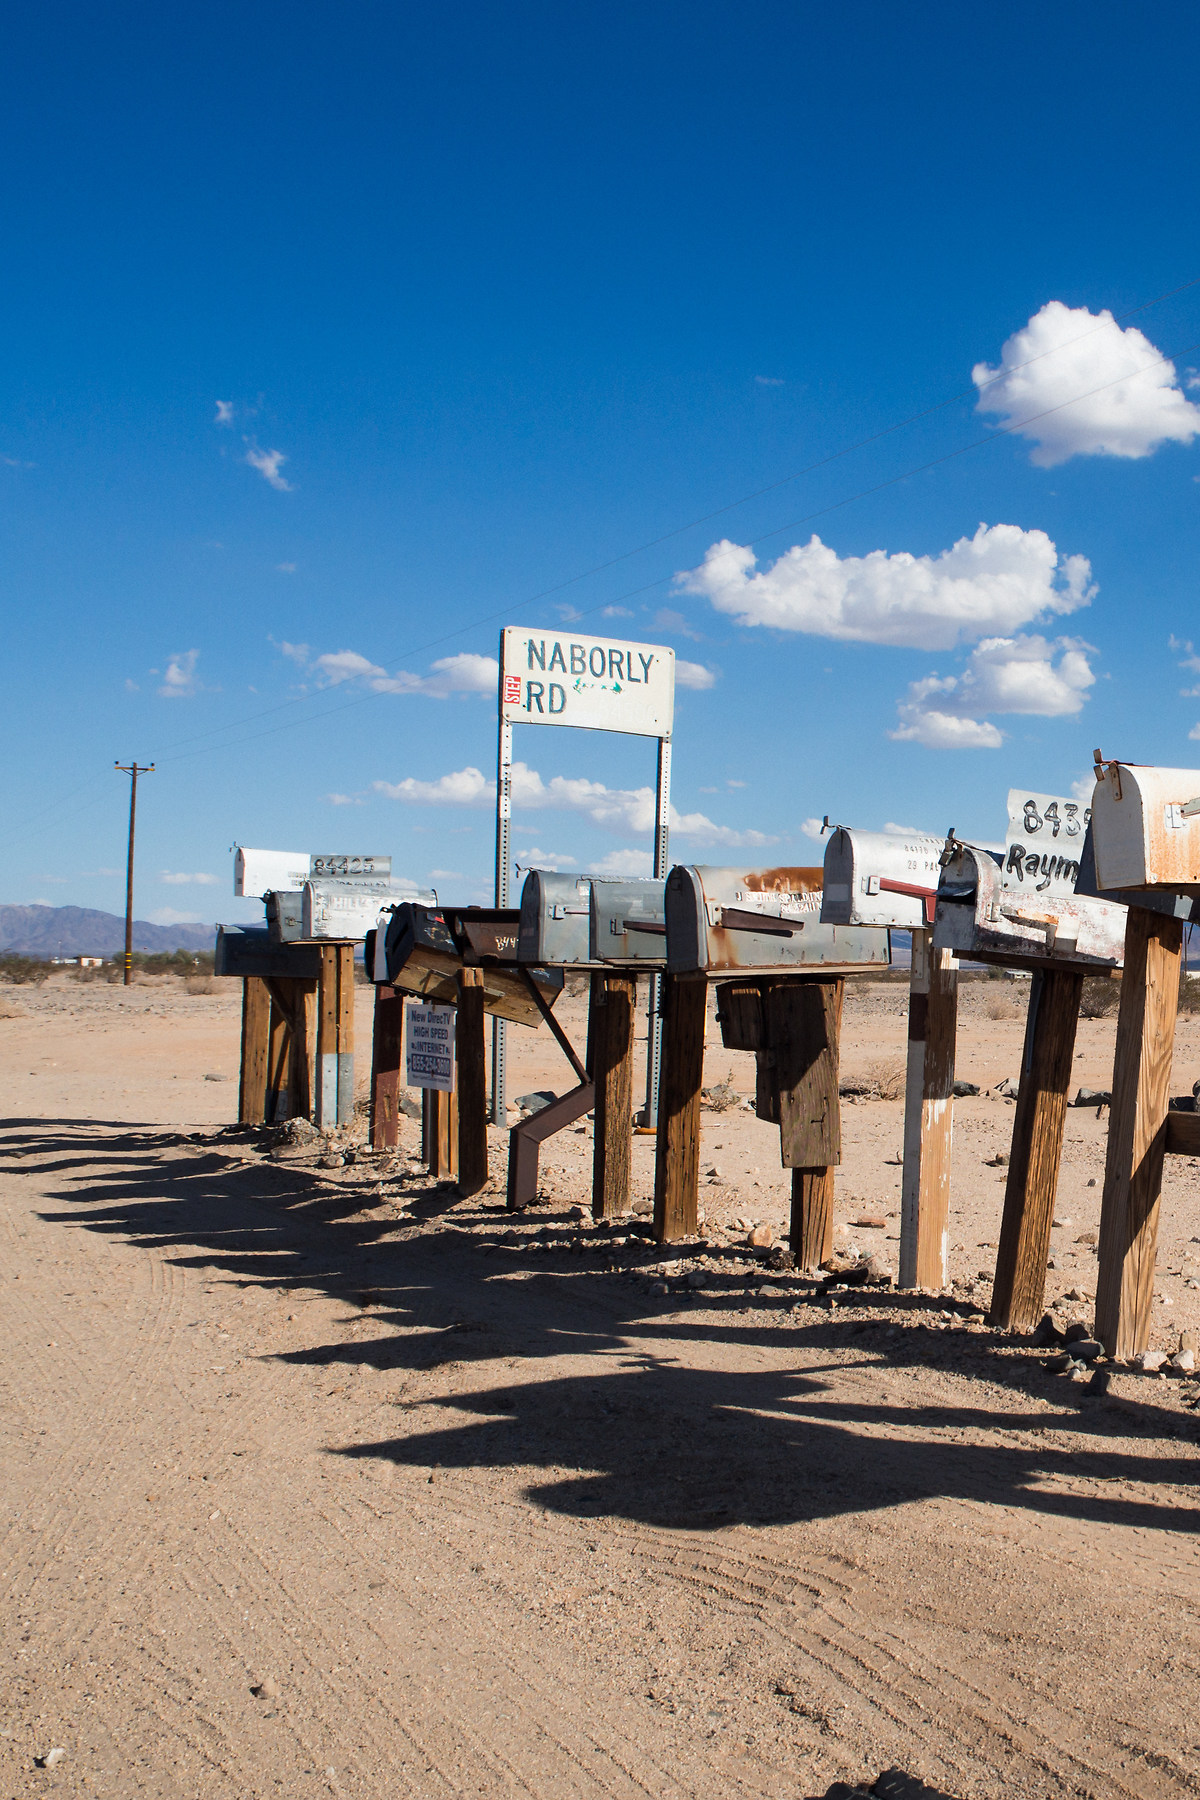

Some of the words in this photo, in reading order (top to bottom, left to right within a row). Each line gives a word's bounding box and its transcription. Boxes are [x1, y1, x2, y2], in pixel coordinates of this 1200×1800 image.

[527, 638, 654, 684] NABORLY
[504, 676, 521, 703] STEP
[526, 680, 567, 714] RD
[313, 857, 375, 876] 84425
[494, 936, 520, 951] 844
[411, 1010, 426, 1023] New
[427, 1011, 451, 1026] DirecTV
[413, 1025, 430, 1038] HIGH
[430, 1027, 448, 1040] SPEED
[416, 1041, 446, 1054] INTERNET
